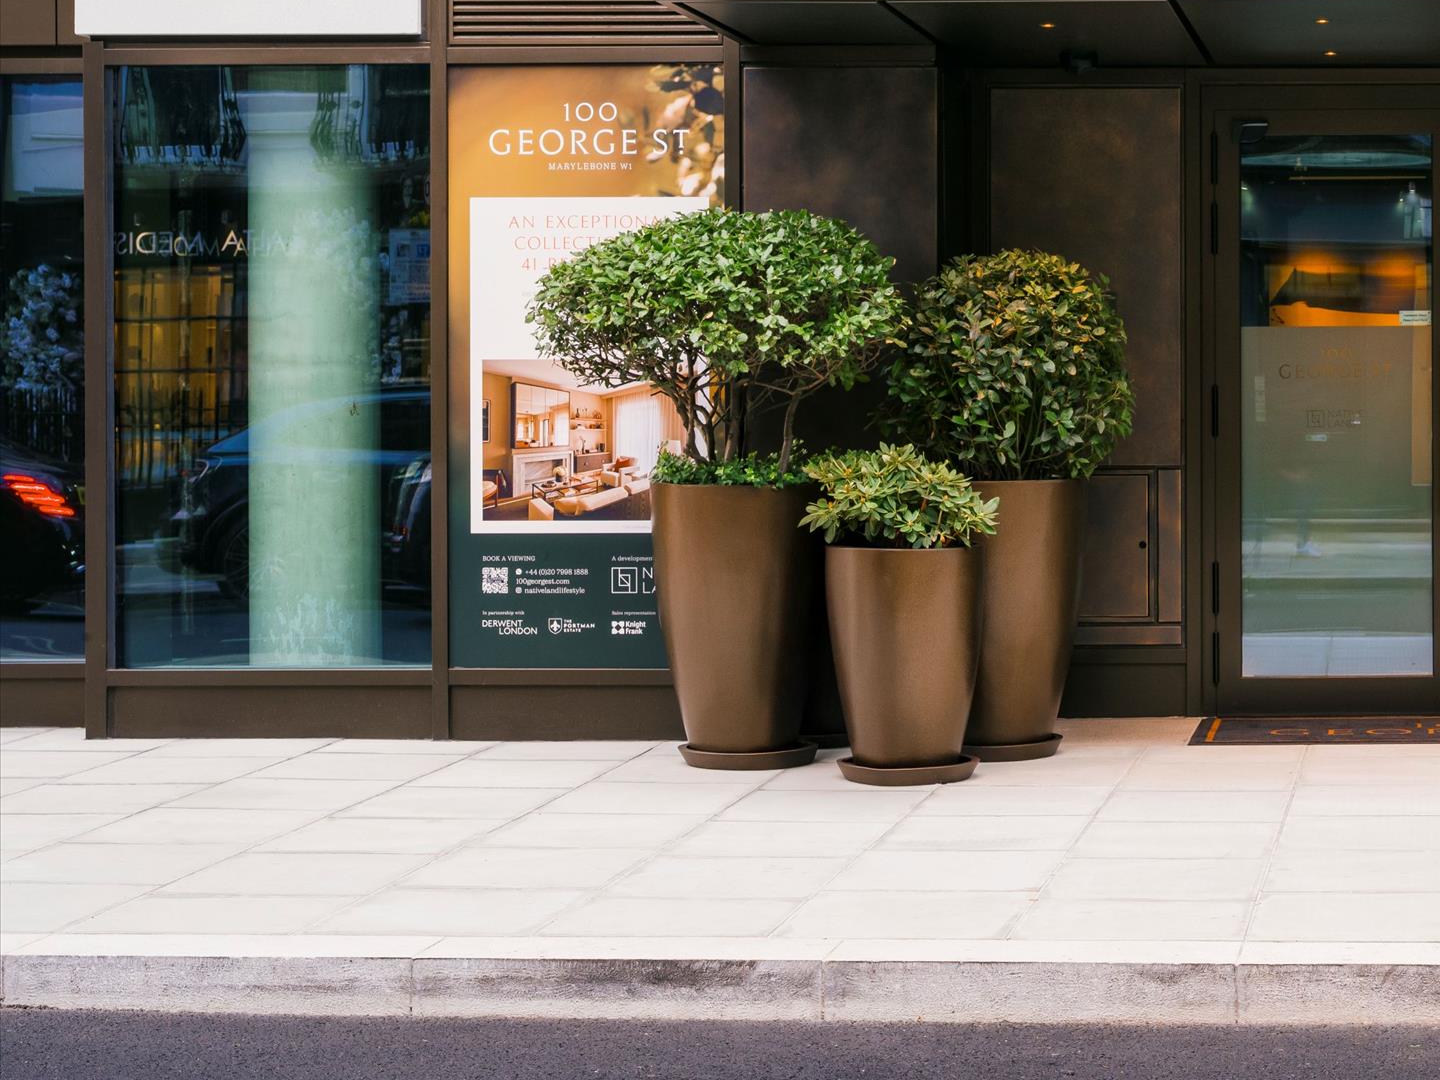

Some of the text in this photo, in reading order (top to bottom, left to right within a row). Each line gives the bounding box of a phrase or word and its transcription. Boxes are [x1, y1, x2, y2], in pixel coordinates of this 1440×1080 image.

[563, 102, 618, 122] 100
[489, 128, 638, 156] GEORGE
[548, 162, 633, 171] MARYLEBONE W1
[508, 215, 535, 229] AN
[617, 555, 653, 563] developmen
[538, 568, 556, 577] (0)20
[515, 577, 570, 586] 100georgest.com
[524, 587, 586, 596] nativelandlifestyle
[481, 620, 523, 628] DERWENT
[625, 620, 646, 629] Knight
[499, 627, 538, 635] LONDON
